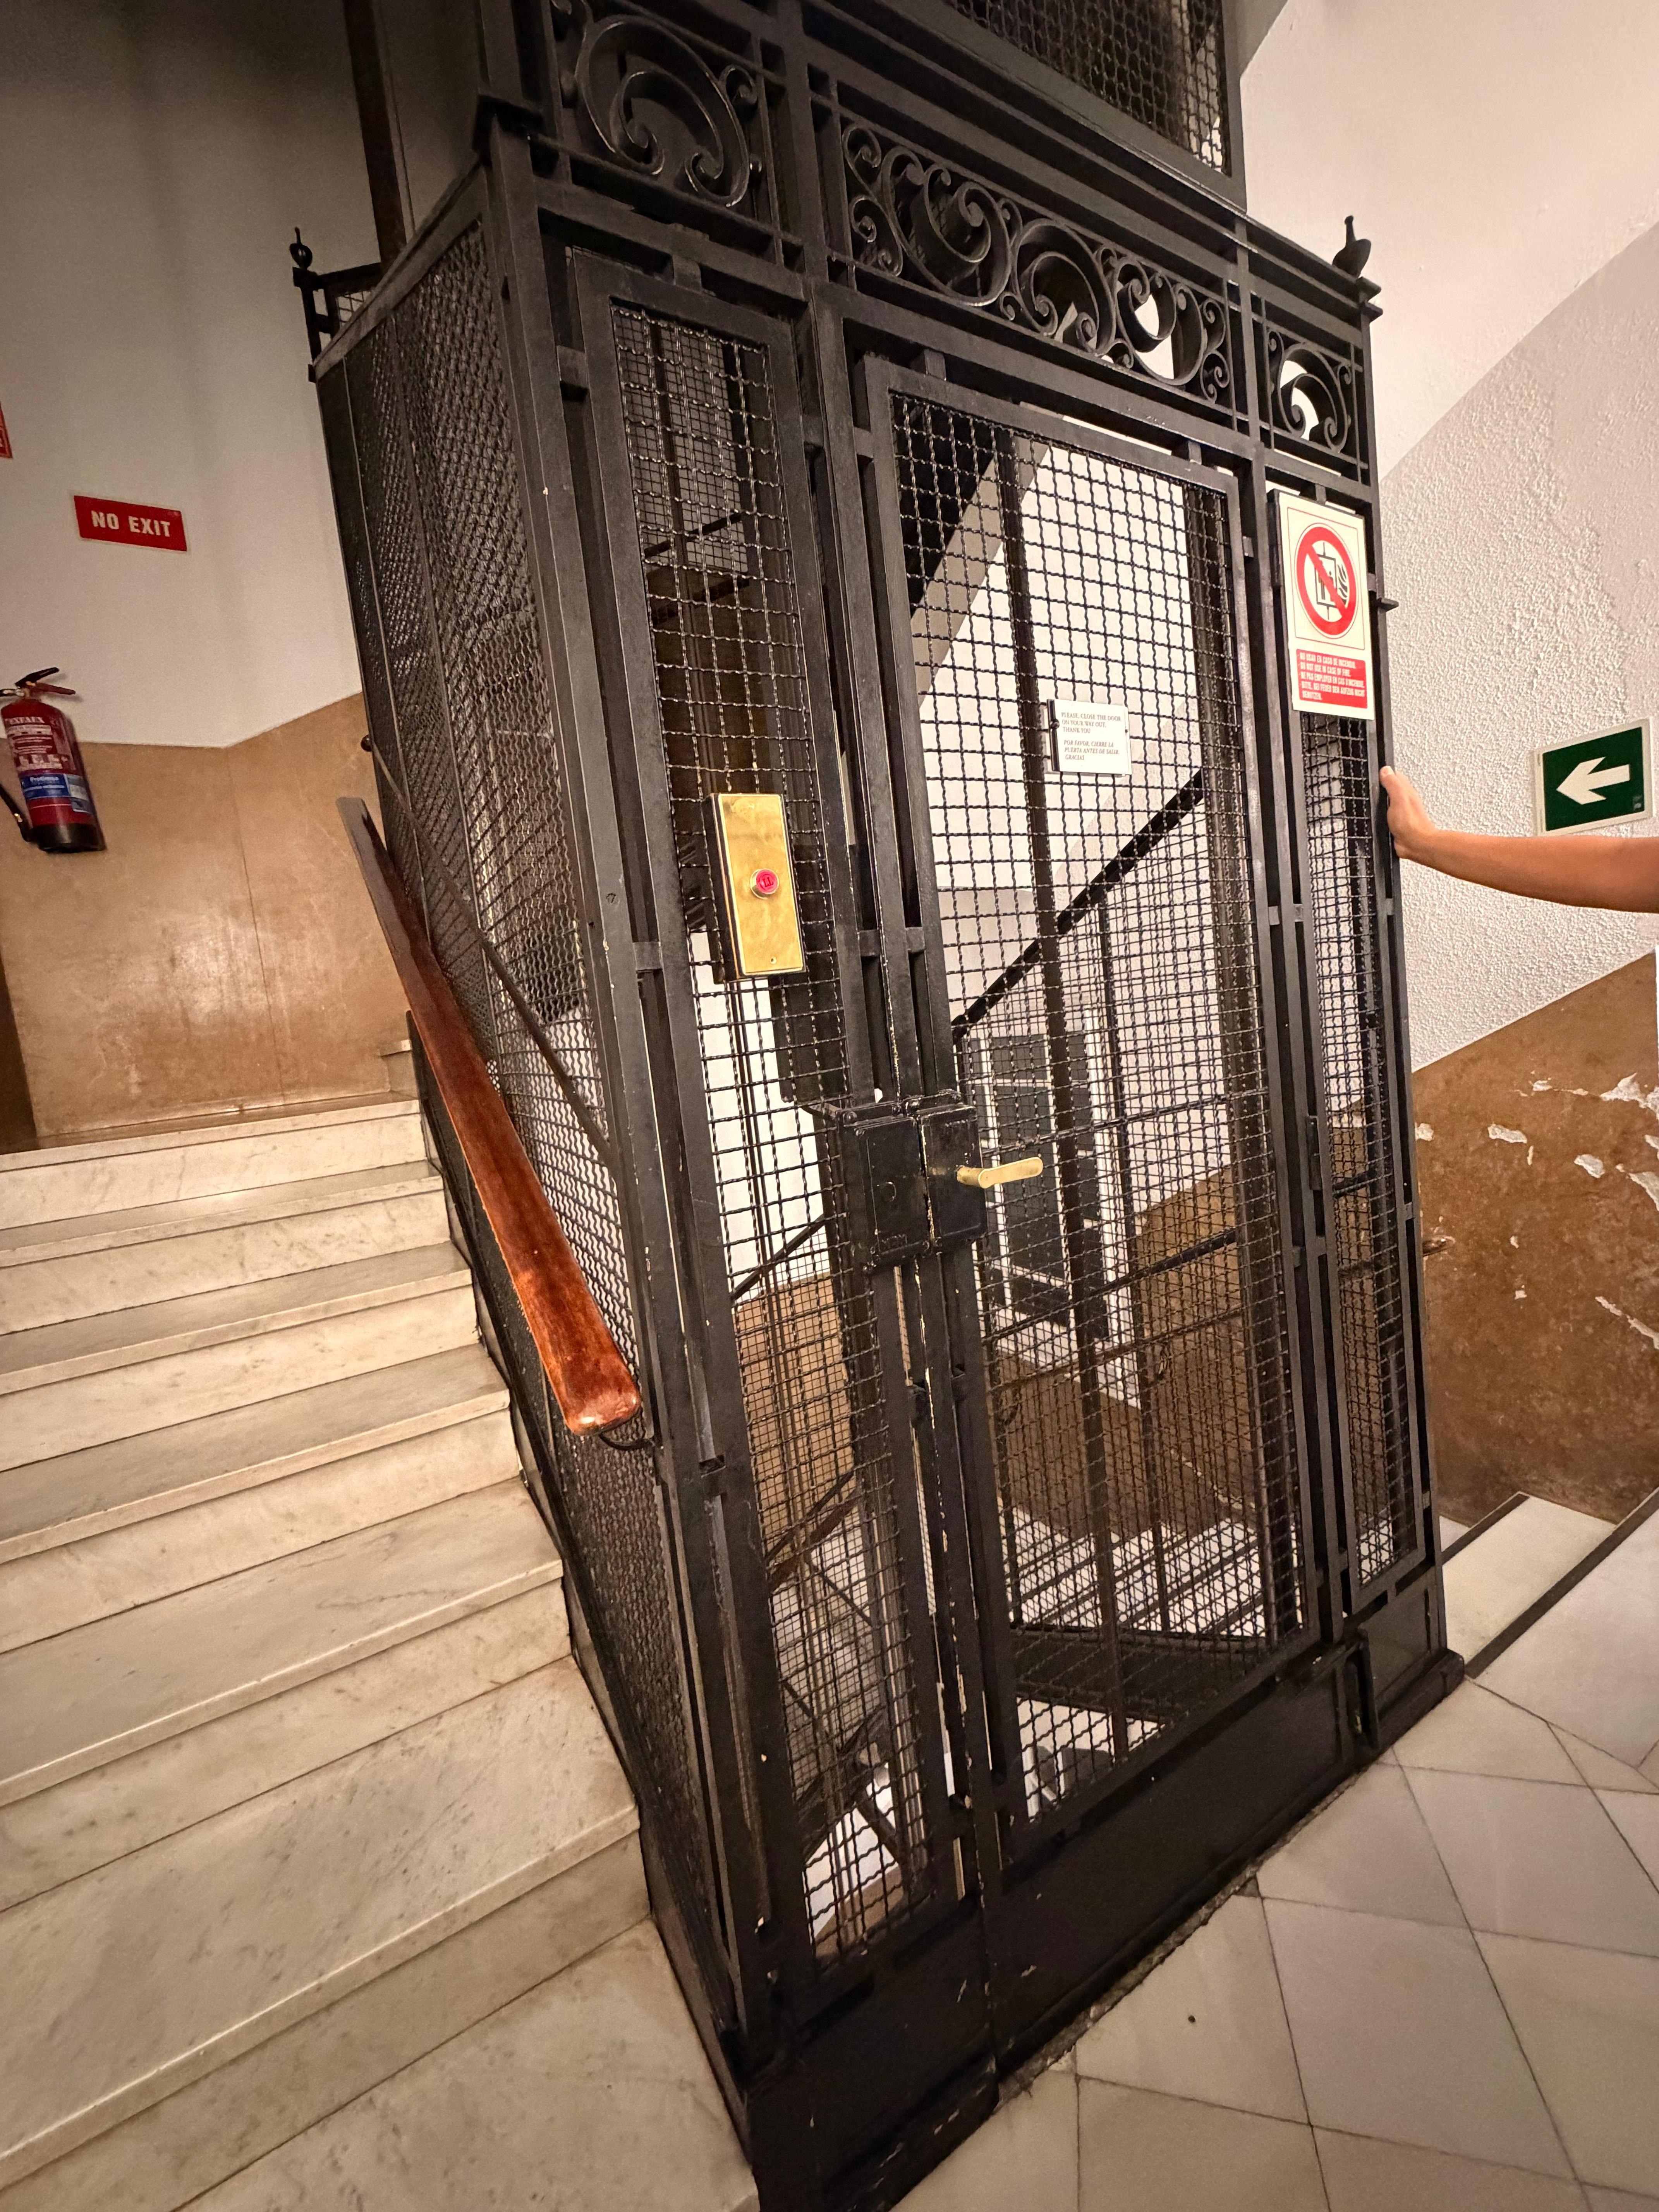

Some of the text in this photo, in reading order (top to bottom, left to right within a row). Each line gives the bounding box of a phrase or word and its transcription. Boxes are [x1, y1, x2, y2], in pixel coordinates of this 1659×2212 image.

[91, 510, 170, 537] NO EXIT
[1322, 656, 1332, 665] CASO
[1327, 666, 1336, 675] CASE
